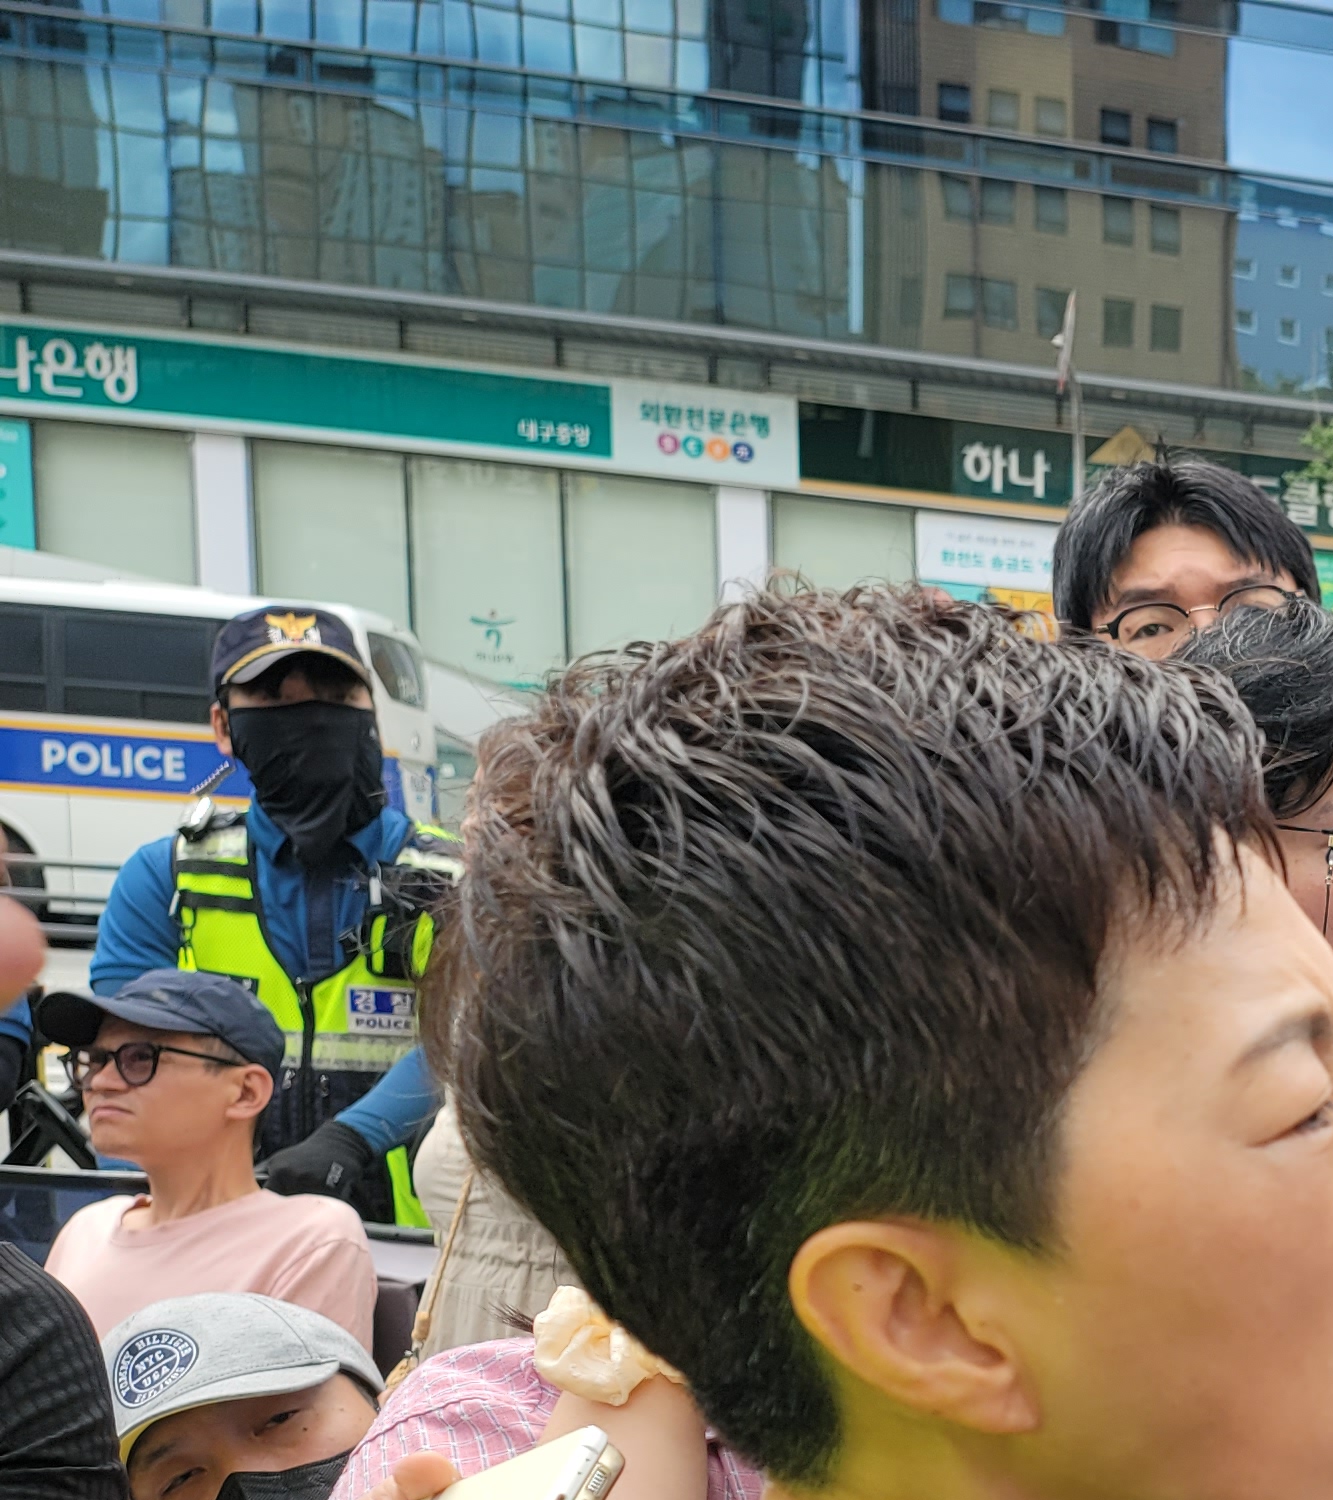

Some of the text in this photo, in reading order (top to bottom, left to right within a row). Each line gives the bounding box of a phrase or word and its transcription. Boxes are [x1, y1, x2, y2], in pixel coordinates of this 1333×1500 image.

[962, 441, 1052, 499] 하나
[41, 738, 187, 782] POLICE
[355, 1016, 412, 1030] POLICE
[118, 1333, 193, 1397] TOMMY HILFIGER
[134, 1350, 165, 1375] NYC
[142, 1365, 171, 1388] USA
